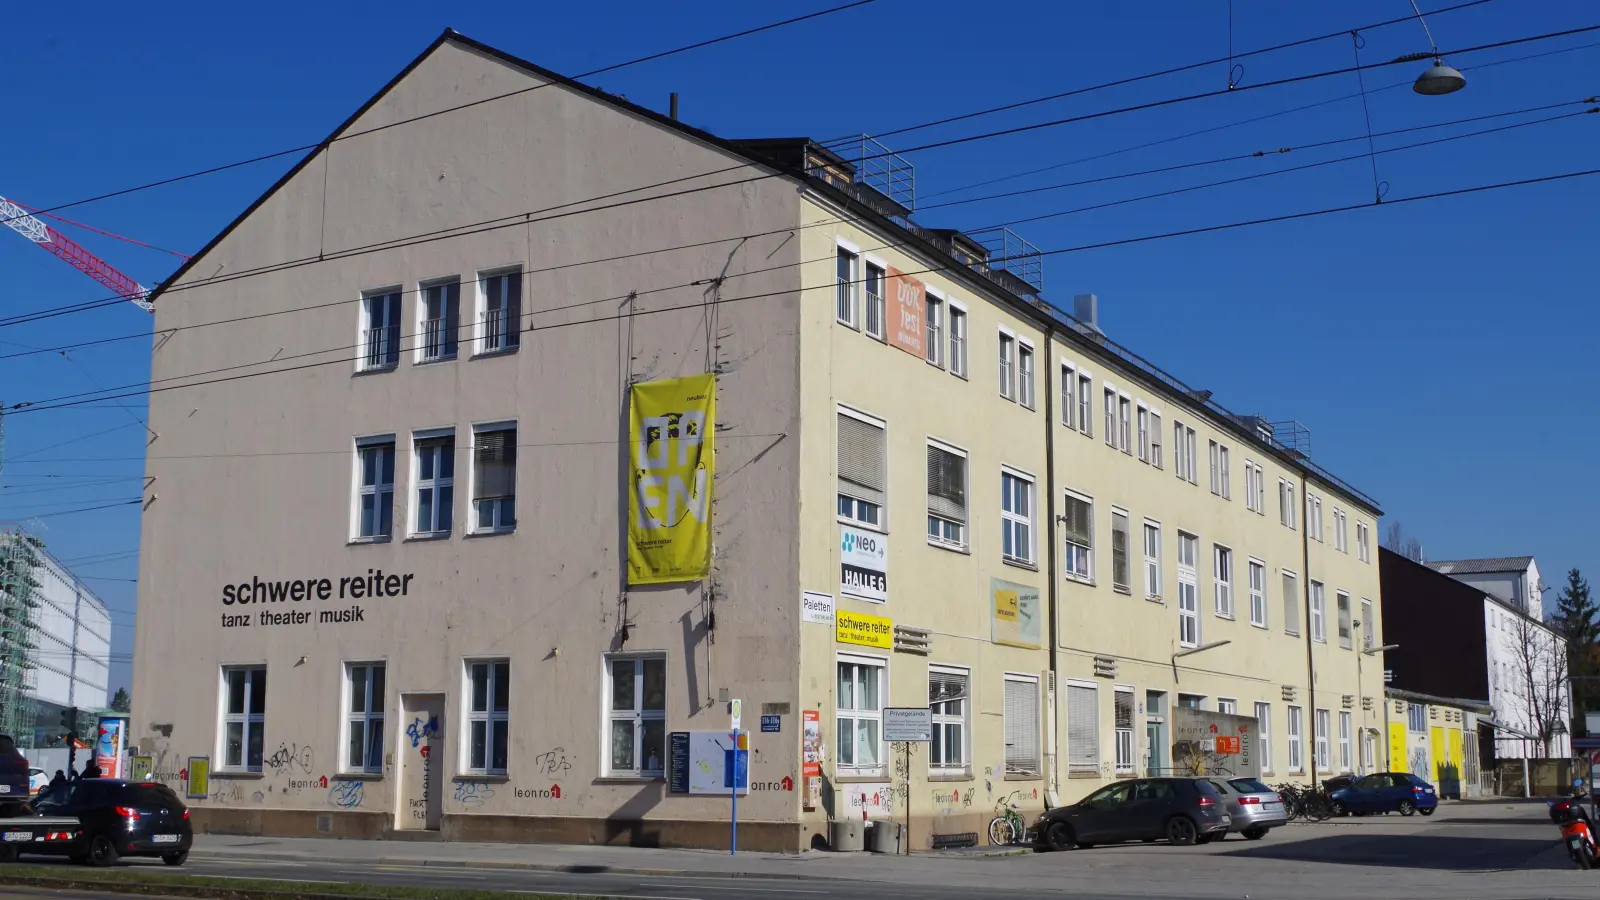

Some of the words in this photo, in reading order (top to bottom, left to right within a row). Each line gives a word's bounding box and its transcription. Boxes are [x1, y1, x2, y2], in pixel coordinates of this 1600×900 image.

[856, 535, 876, 552] Neo
[222, 576, 331, 605] schwere
[339, 568, 414, 599] reiter
[845, 569, 877, 590] HALLE
[878, 577, 885, 592] 6
[803, 598, 831, 612] Paletten
[221, 612, 250, 627] tanz
[260, 609, 311, 625] theater
[319, 605, 364, 623] musik
[839, 616, 871, 632] schwere
[871, 622, 890, 634] reiter
[288, 776, 328, 789] leonrod
[751, 776, 793, 791] onrod
[514, 784, 560, 799] leonrod
